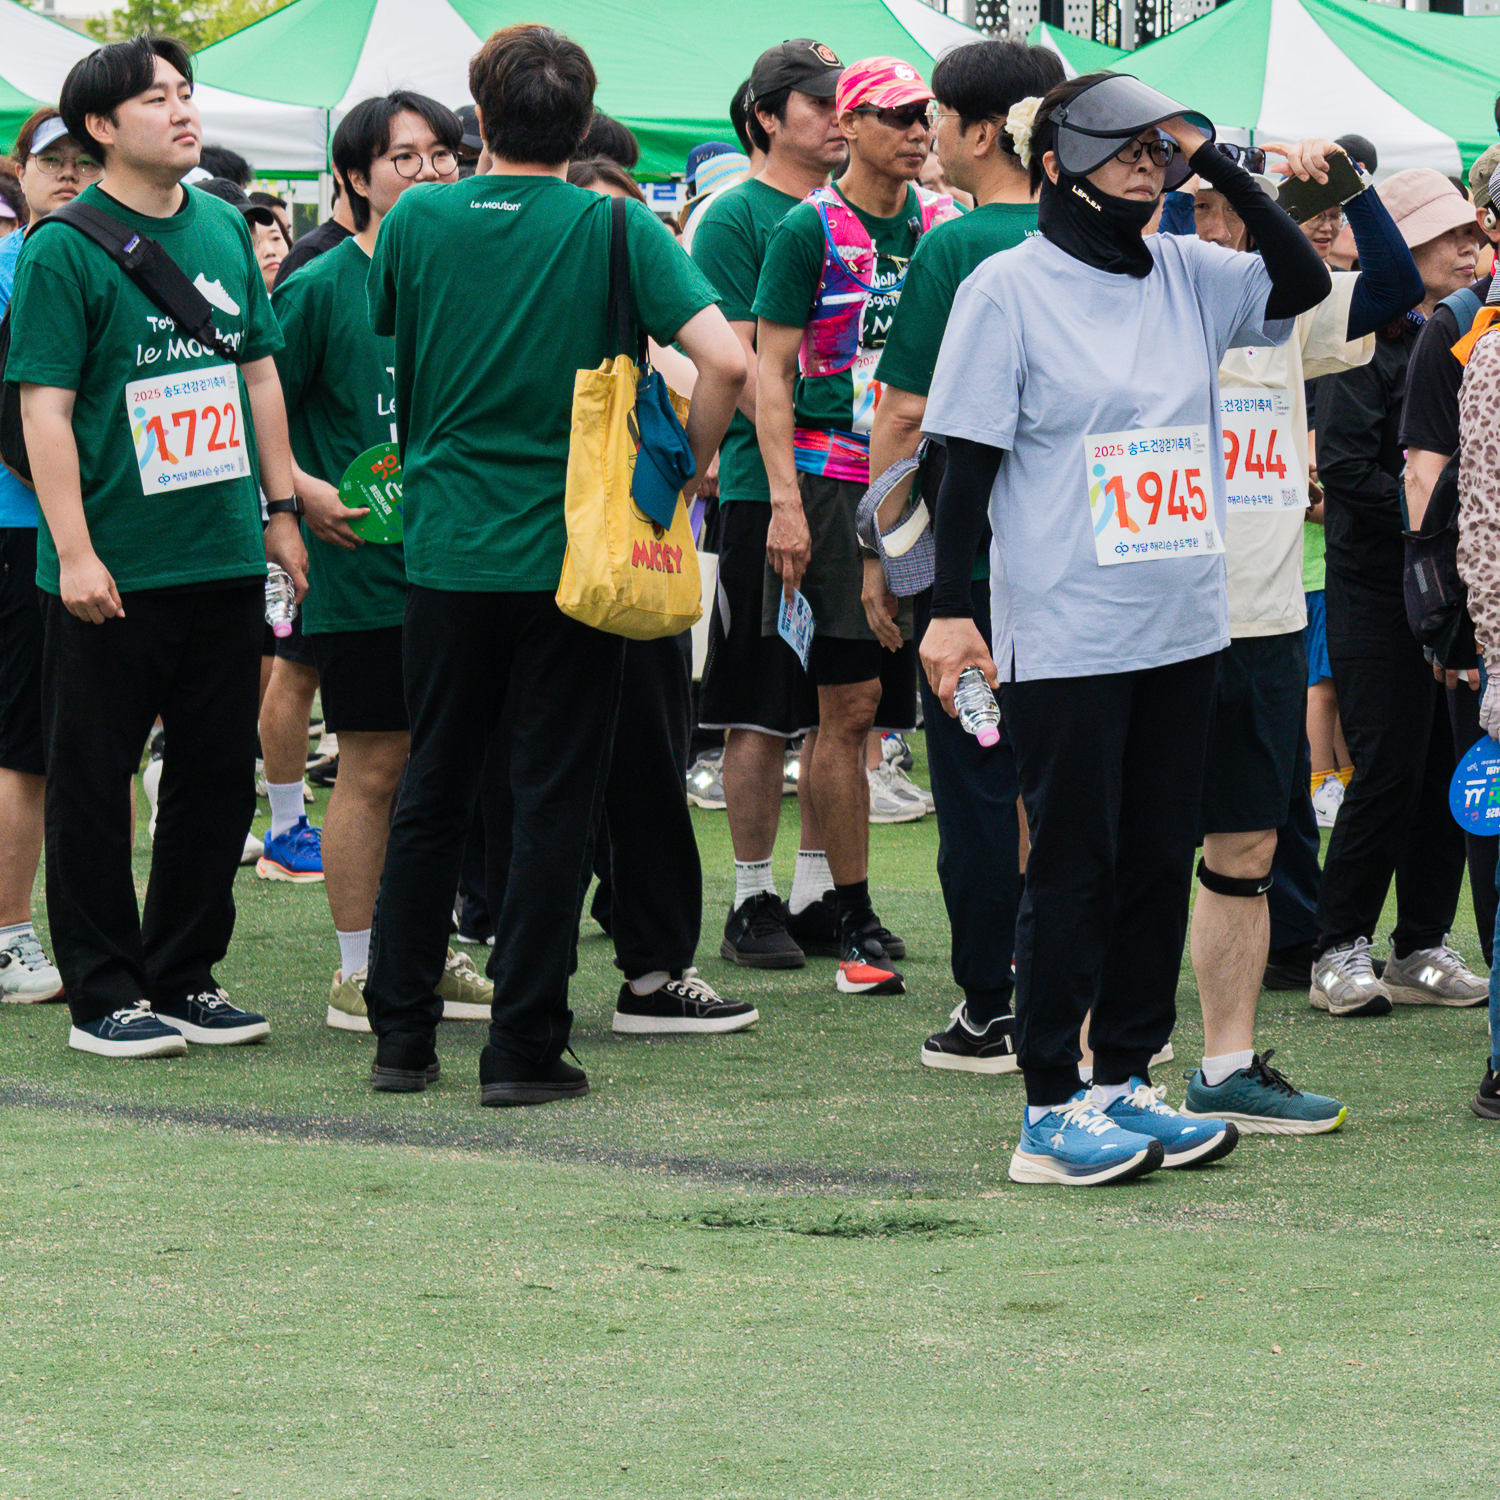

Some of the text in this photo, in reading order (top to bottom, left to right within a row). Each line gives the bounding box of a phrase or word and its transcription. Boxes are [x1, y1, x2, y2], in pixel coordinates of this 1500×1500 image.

[470, 200, 484, 210] Le
[136, 343, 162, 367] Le
[134, 375, 227, 403] 2025 송도건강걷기축제
[1220, 398, 1273, 413] 건강걷기축제
[146, 402, 241, 462] 1722
[1094, 436, 1191, 458] 2025 송도건강걷기축제
[1222, 429, 1288, 481] 944
[1104, 468, 1208, 529] 1945
[1419, 965, 1443, 987] N
